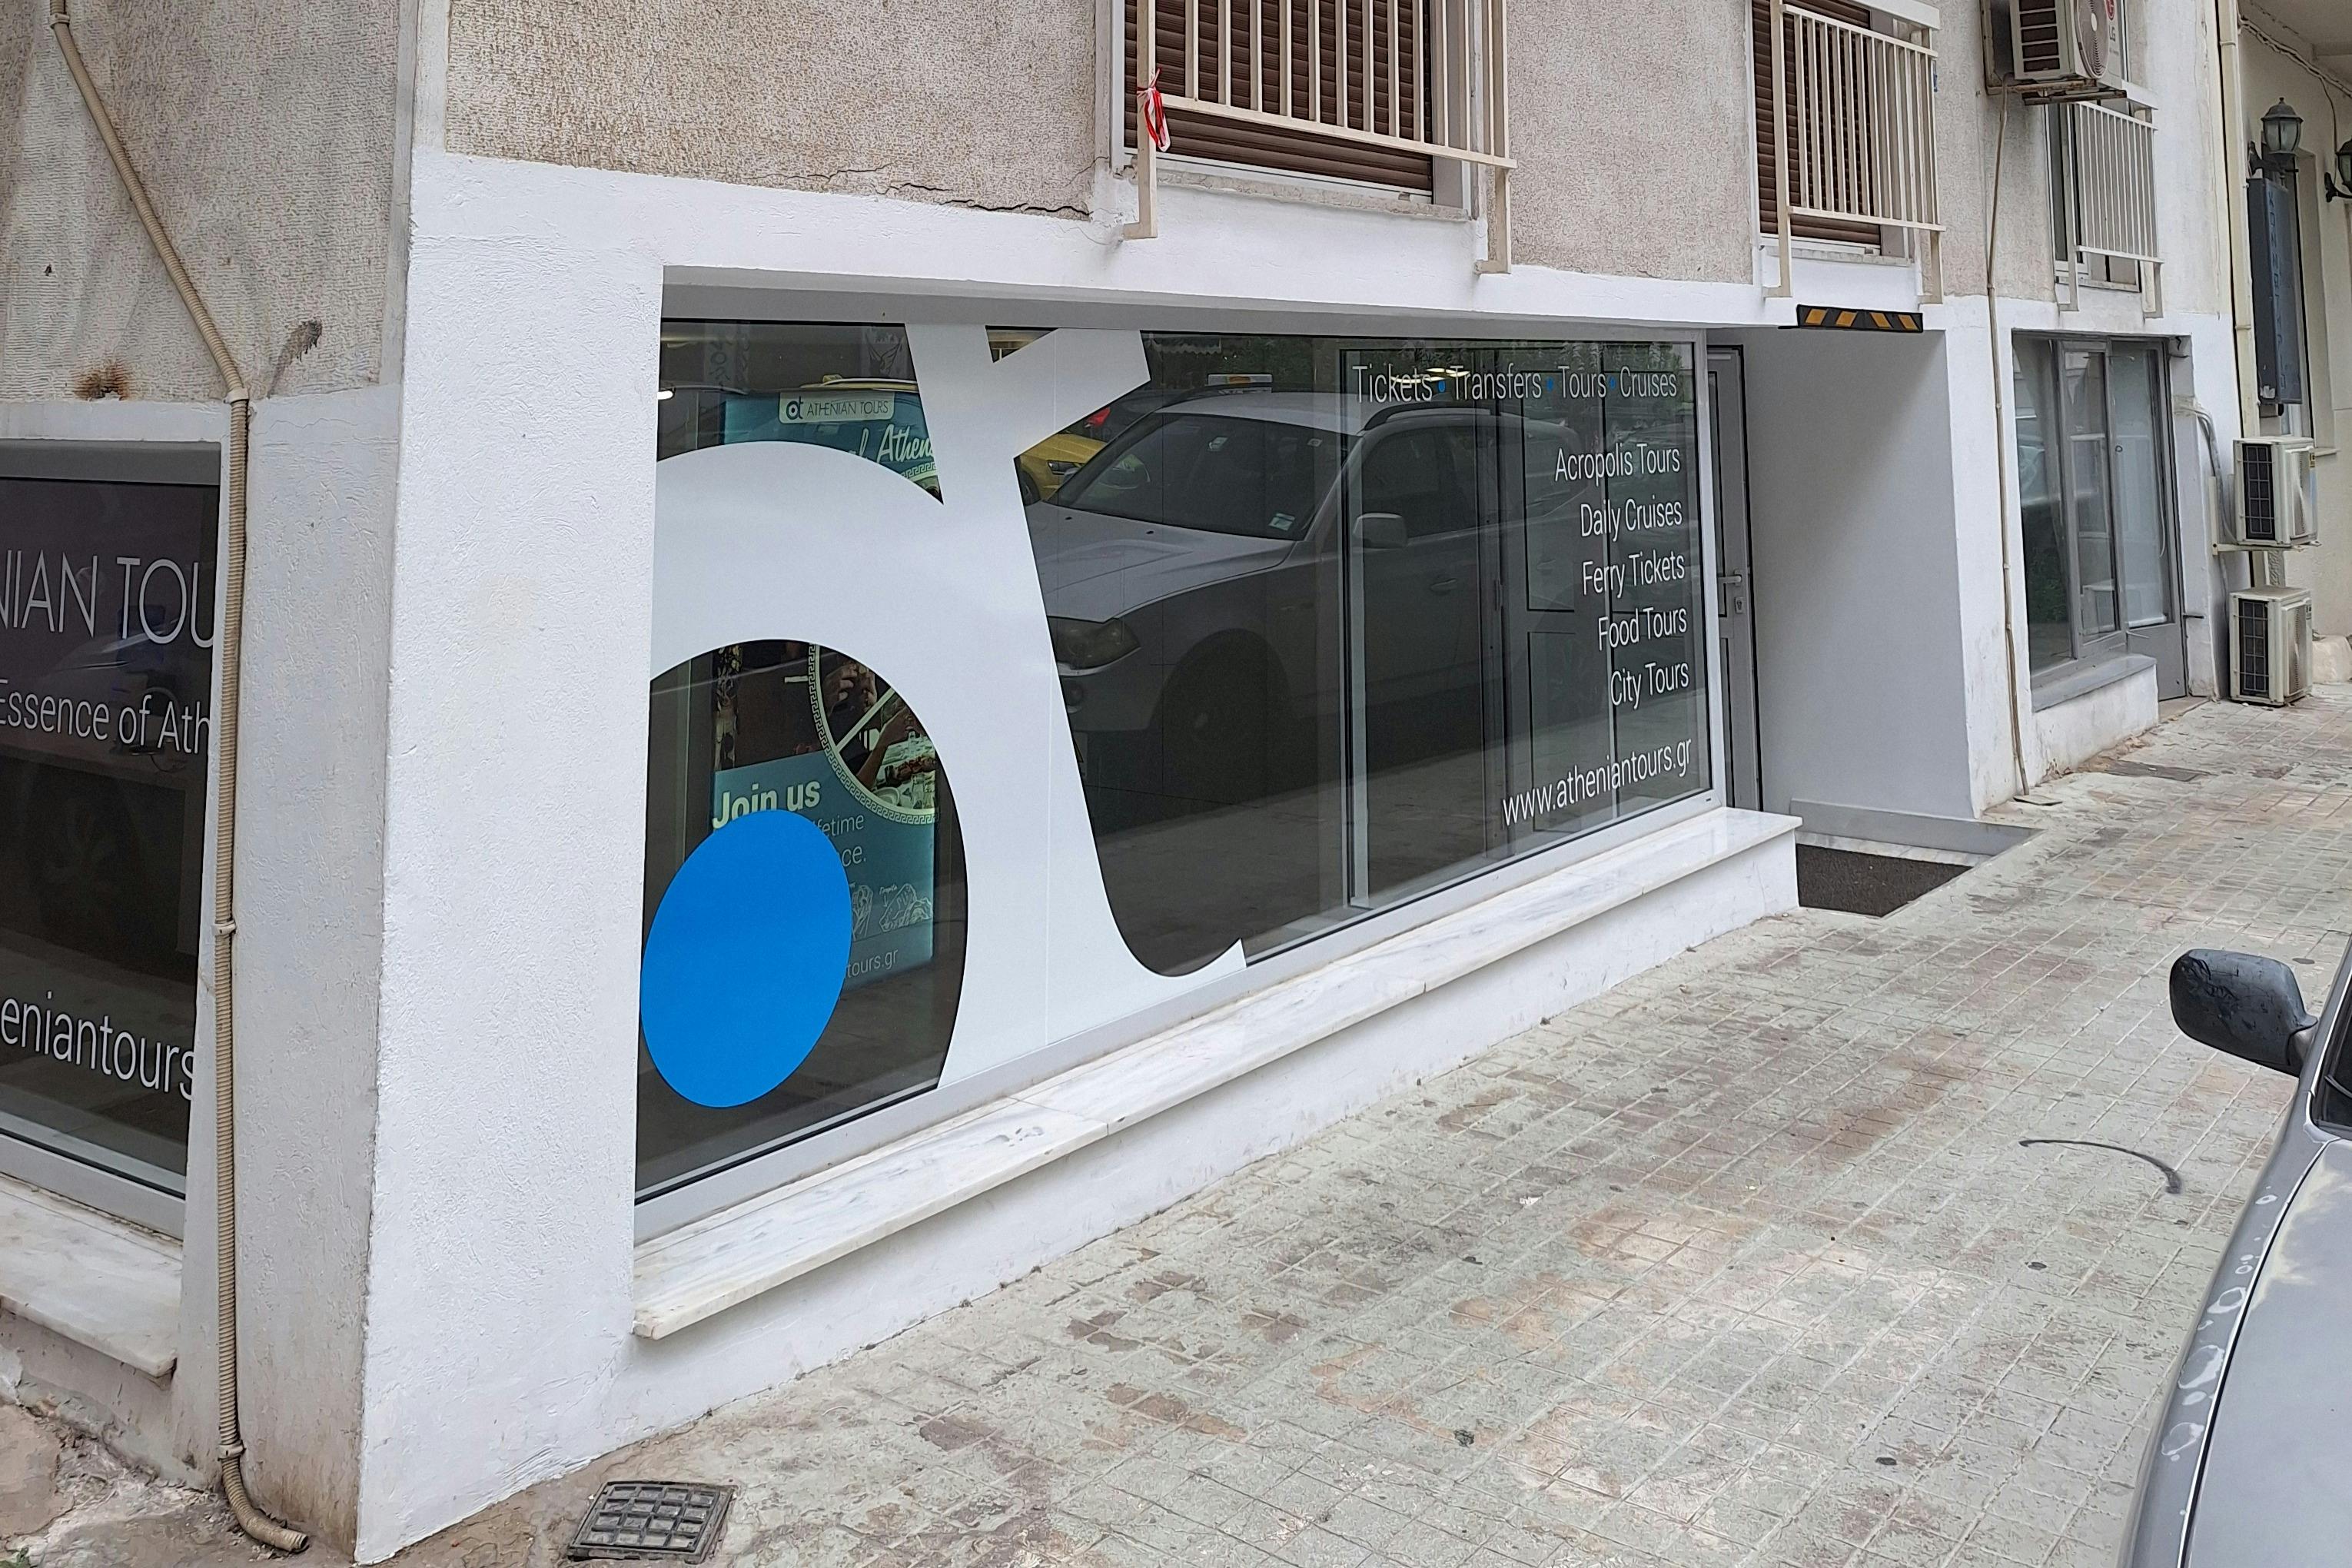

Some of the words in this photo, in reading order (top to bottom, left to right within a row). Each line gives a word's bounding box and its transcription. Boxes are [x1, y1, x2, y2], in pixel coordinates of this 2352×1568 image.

[1352, 364, 1433, 403] Tickets
[1450, 363, 1543, 400] Transfers
[1557, 364, 1607, 399] Tours
[1619, 365, 1677, 398] Cruises
[806, 401, 857, 417] ATHENIAN
[860, 400, 889, 414] TOURS
[1554, 443, 1633, 487] Acropolis
[1636, 443, 1681, 474] Tours
[1580, 498, 1622, 542] Daily
[1624, 495, 1683, 532] Cruises
[1583, 560, 1626, 599] Ferry
[1628, 549, 1686, 586] Tickets
[1597, 608, 1639, 652] Food
[1643, 606, 1687, 640] Tours
[1610, 667, 1642, 709] City
[1645, 662, 1689, 696] Tours
[118, 694, 152, 746] of
[712, 783, 778, 829] Join
[786, 780, 821, 811] us
[1503, 738, 1692, 827] www.atheniantours.gr
